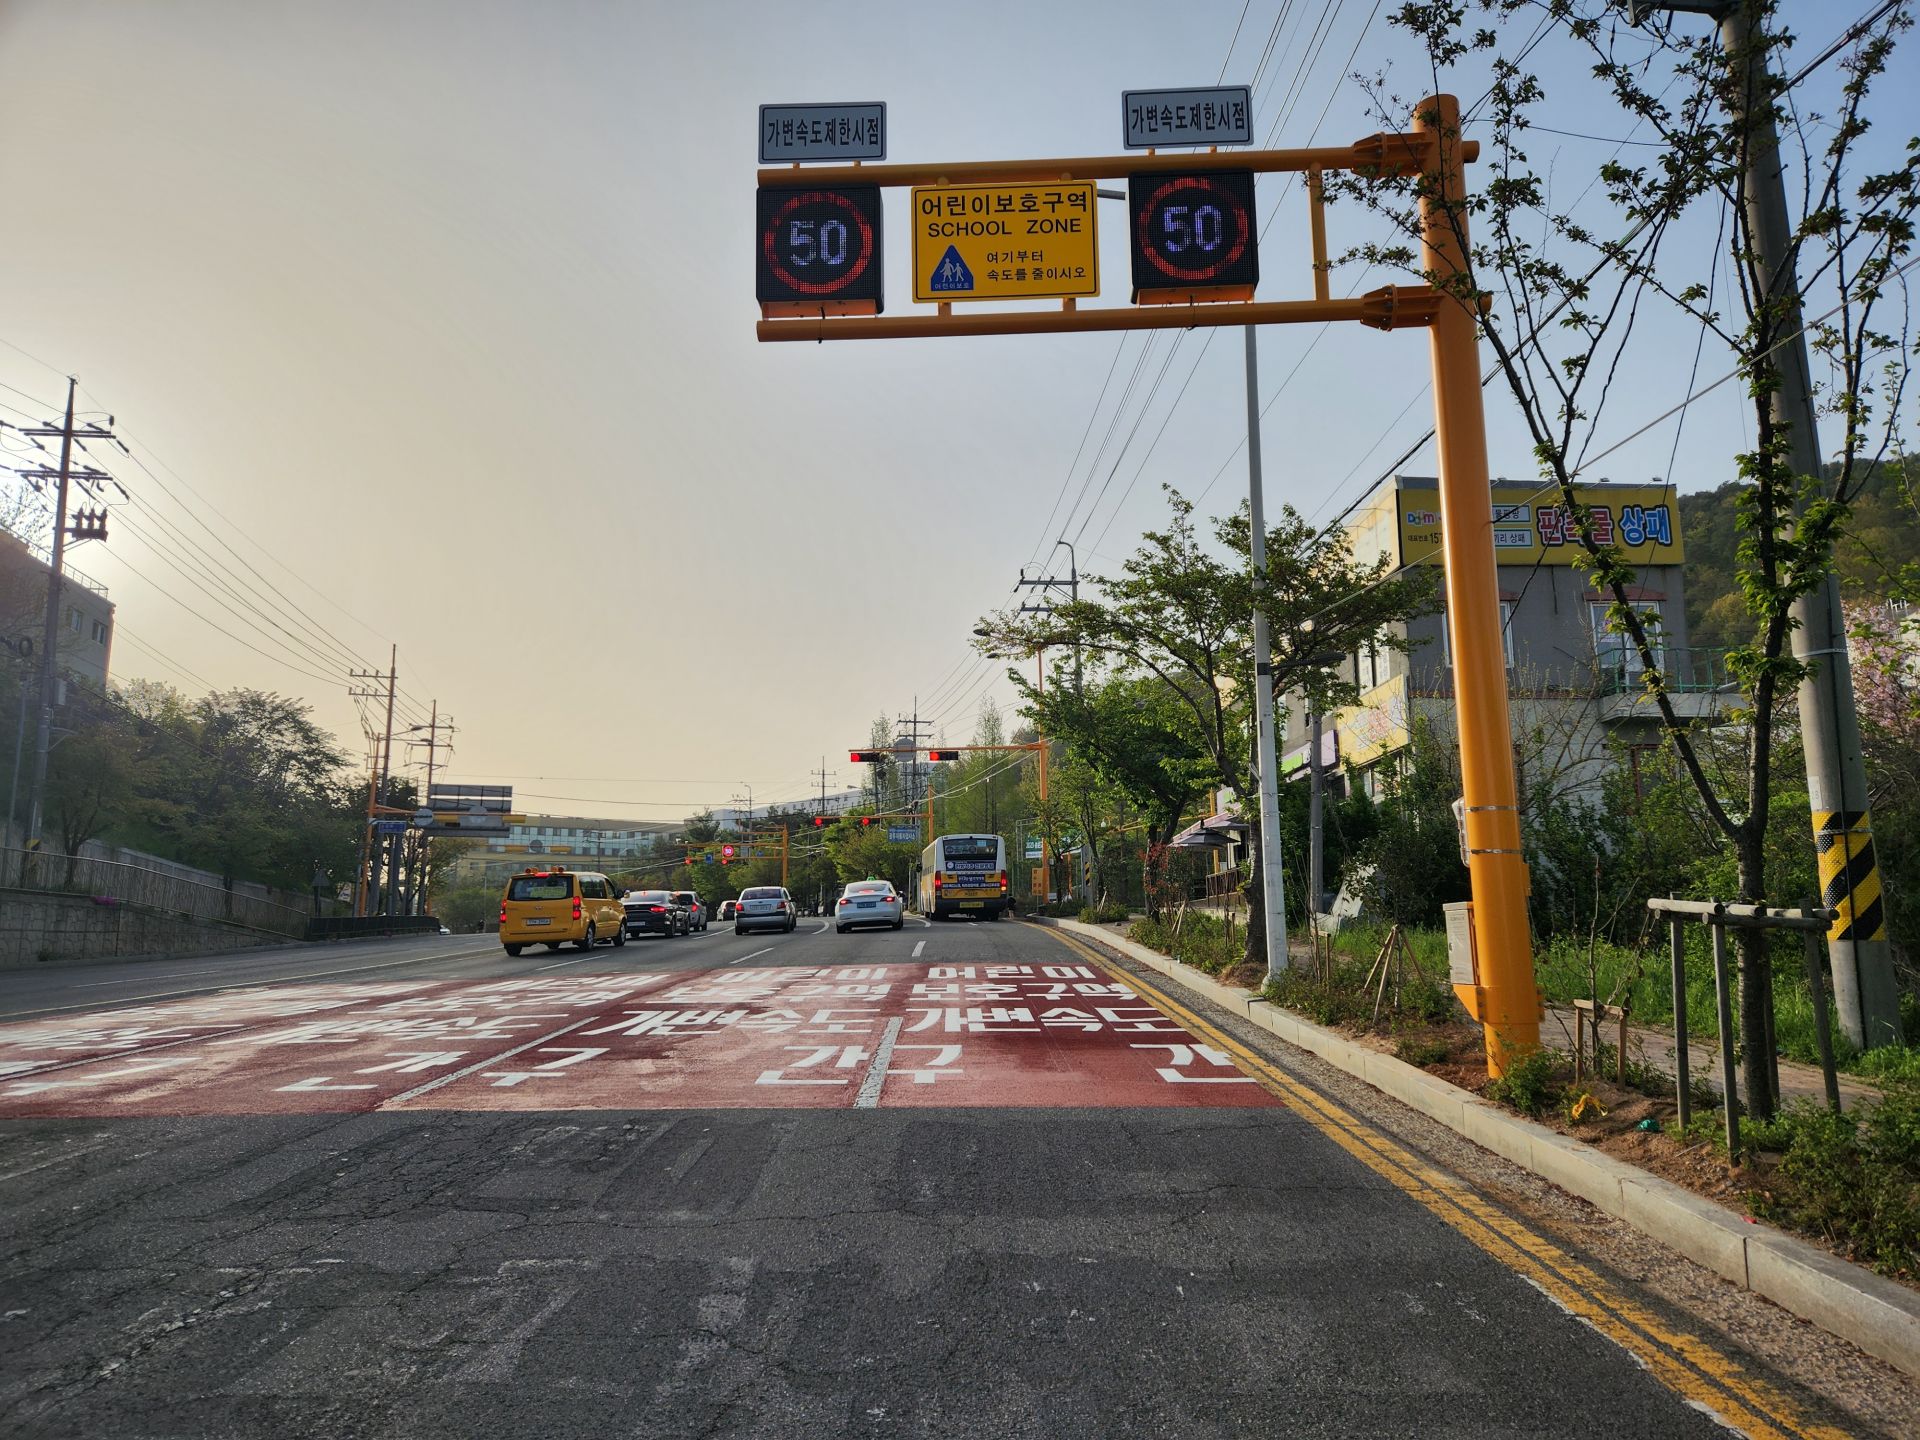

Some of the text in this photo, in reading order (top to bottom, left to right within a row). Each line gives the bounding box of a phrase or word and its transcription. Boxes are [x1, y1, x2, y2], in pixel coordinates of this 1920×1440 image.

[1131, 101, 1245, 134] 가변속도제한시점
[767, 117, 880, 148] 가변속도제한시점
[921, 190, 1087, 217] 어린이보호구역
[928, 218, 1082, 238] SCHOOL ZONE
[1163, 205, 1223, 252] 50
[790, 219, 847, 266] 50
[986, 250, 1044, 264] 여기부터
[986, 266, 1087, 282] 속도를 줄이시오
[1619, 506, 1673, 546] 상패
[712, 967, 889, 984] 어린이
[928, 965, 1097, 979] 어린이
[645, 984, 893, 1004] 보호구역
[909, 983, 1139, 1001] 보호구역
[577, 1009, 881, 1036] 가변속도
[904, 1007, 1189, 1033] 가변속도
